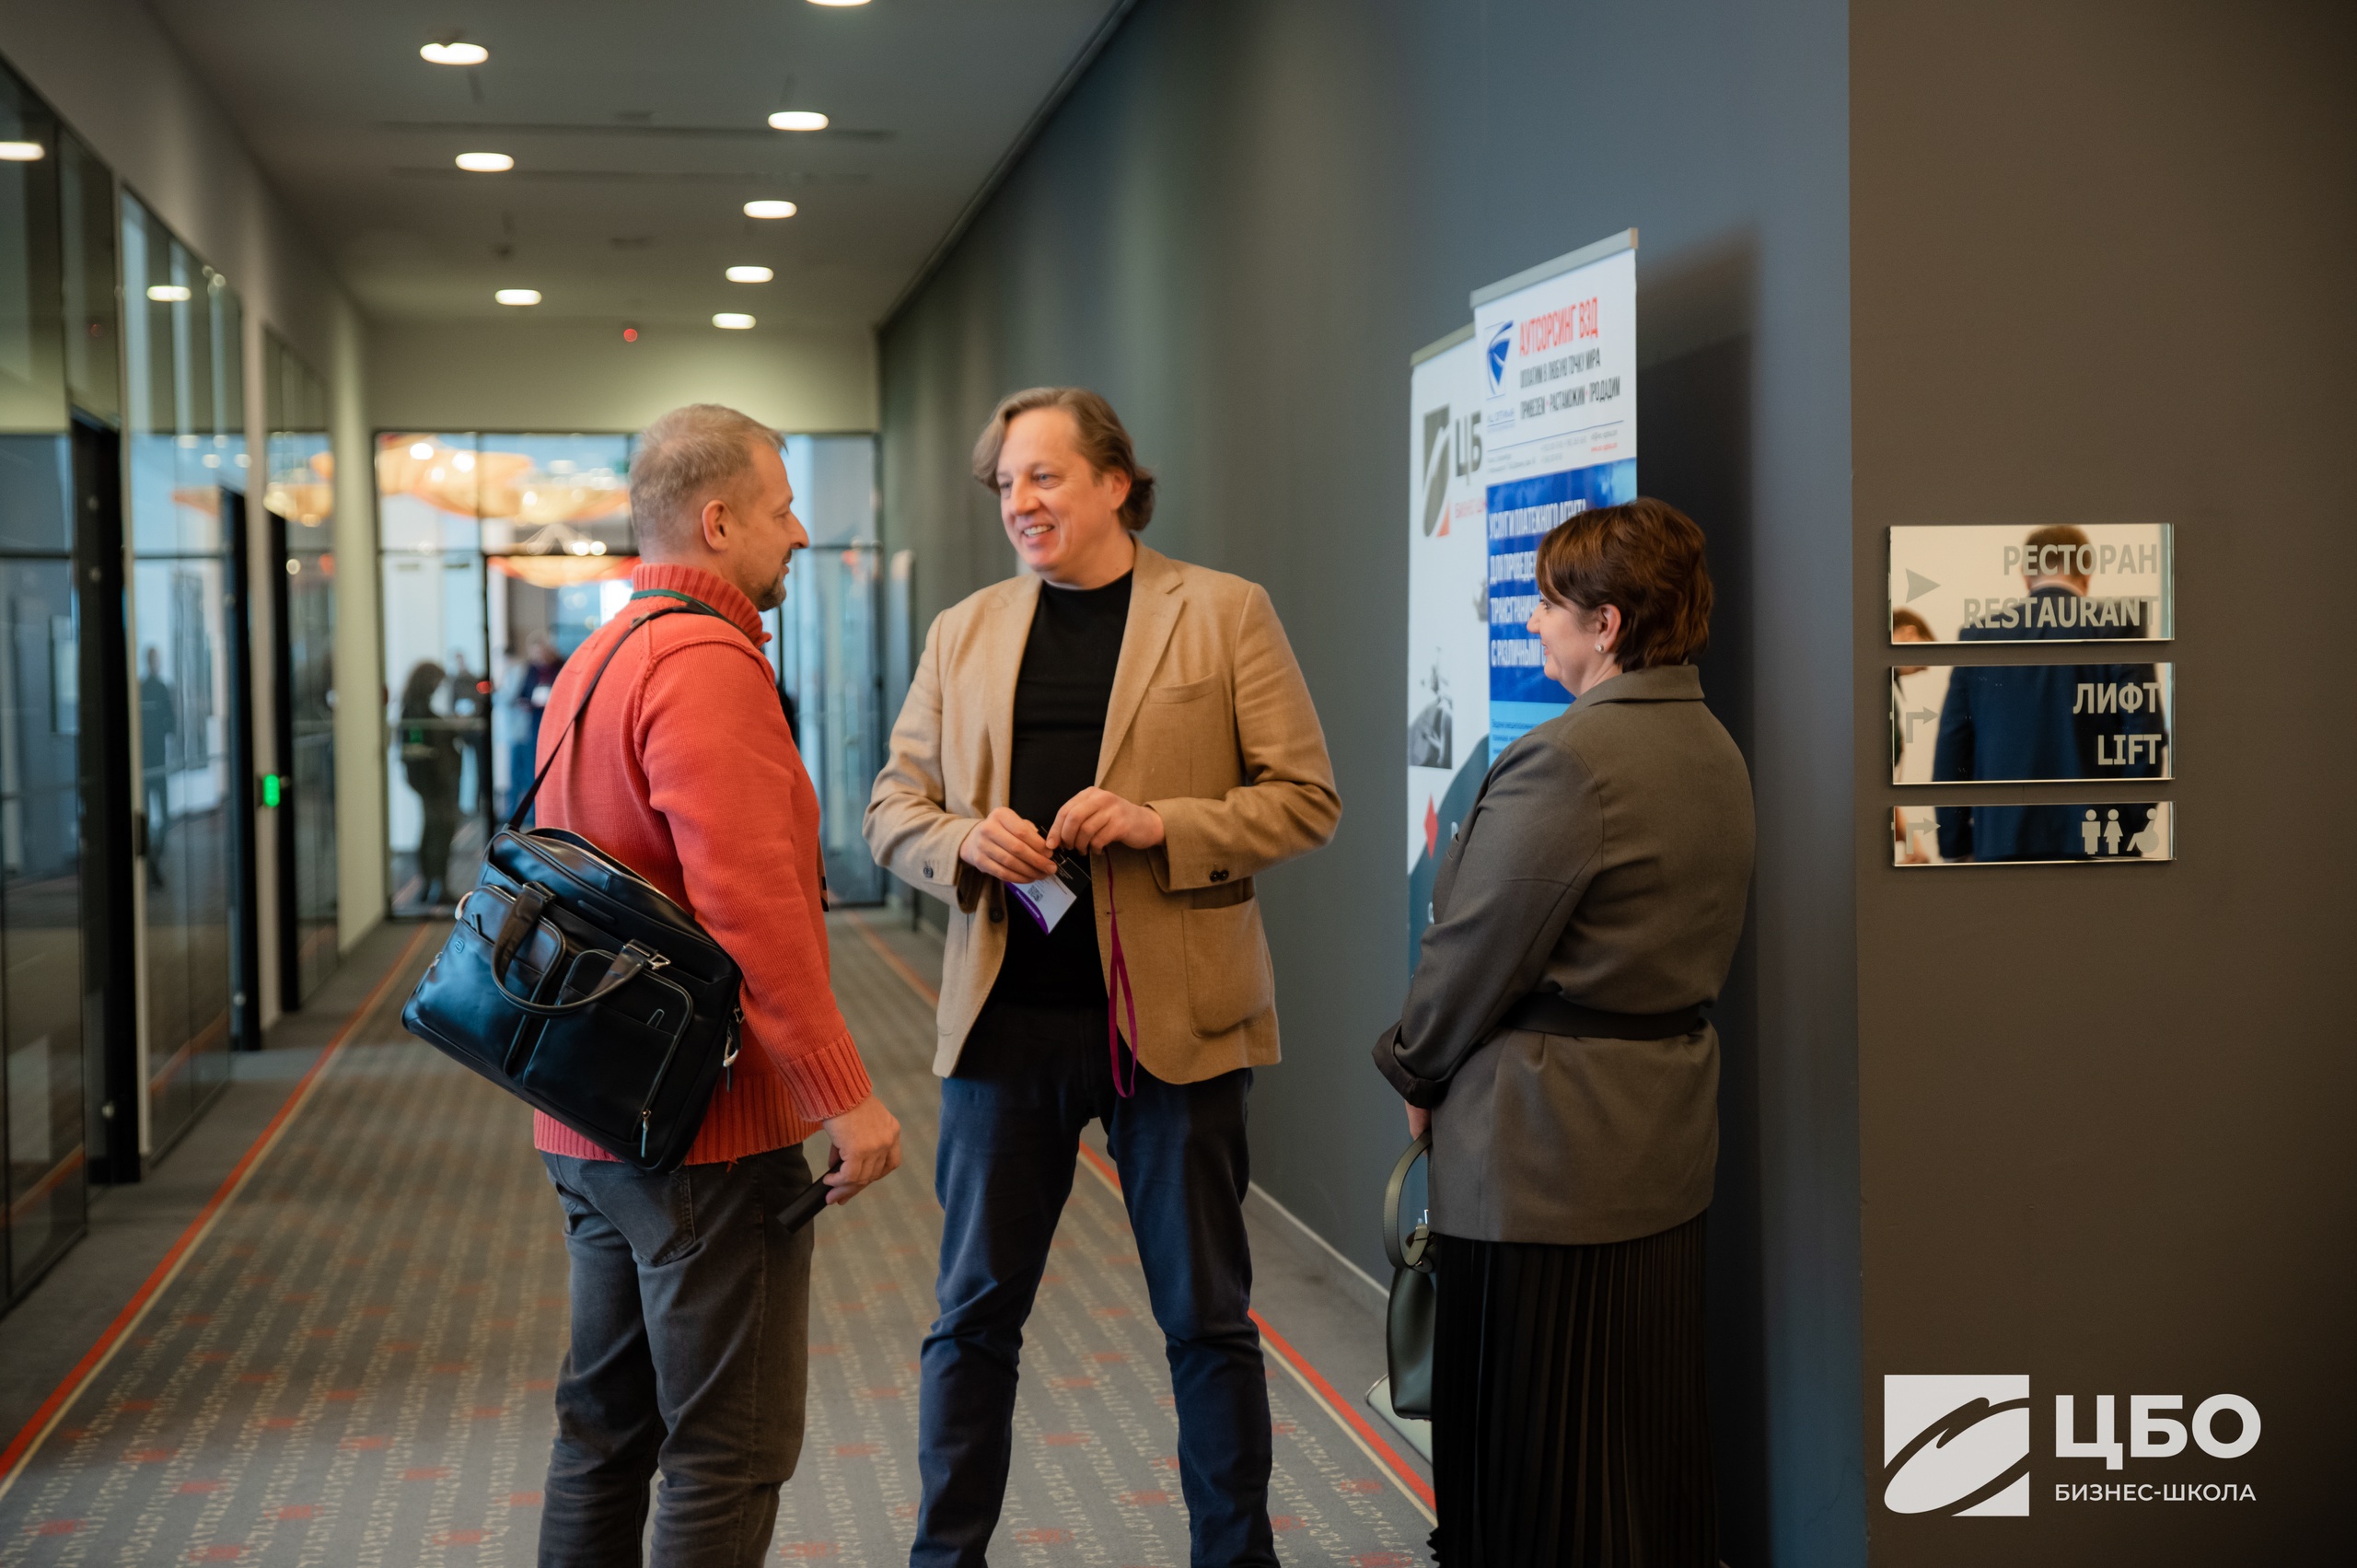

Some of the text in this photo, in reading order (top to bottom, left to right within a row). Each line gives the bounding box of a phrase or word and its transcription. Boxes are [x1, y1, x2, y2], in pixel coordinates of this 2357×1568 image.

[1519, 304, 1576, 356] АУТСОРСИНГ
[1568, 353, 1585, 374] ТОЧКУ
[1585, 347, 1600, 370] МИРА
[1589, 375, 1620, 402] ПРОДАДИМ
[1456, 409, 1482, 485] ЦБ
[1504, 551, 1537, 582] ПРОВЕДЕ
[2003, 543, 2158, 576] РЕСТОРАН
[1963, 596, 2160, 629] RESTAURANT
[2073, 682, 2162, 714] ЛИФТ
[2097, 734, 2162, 766] LIFT
